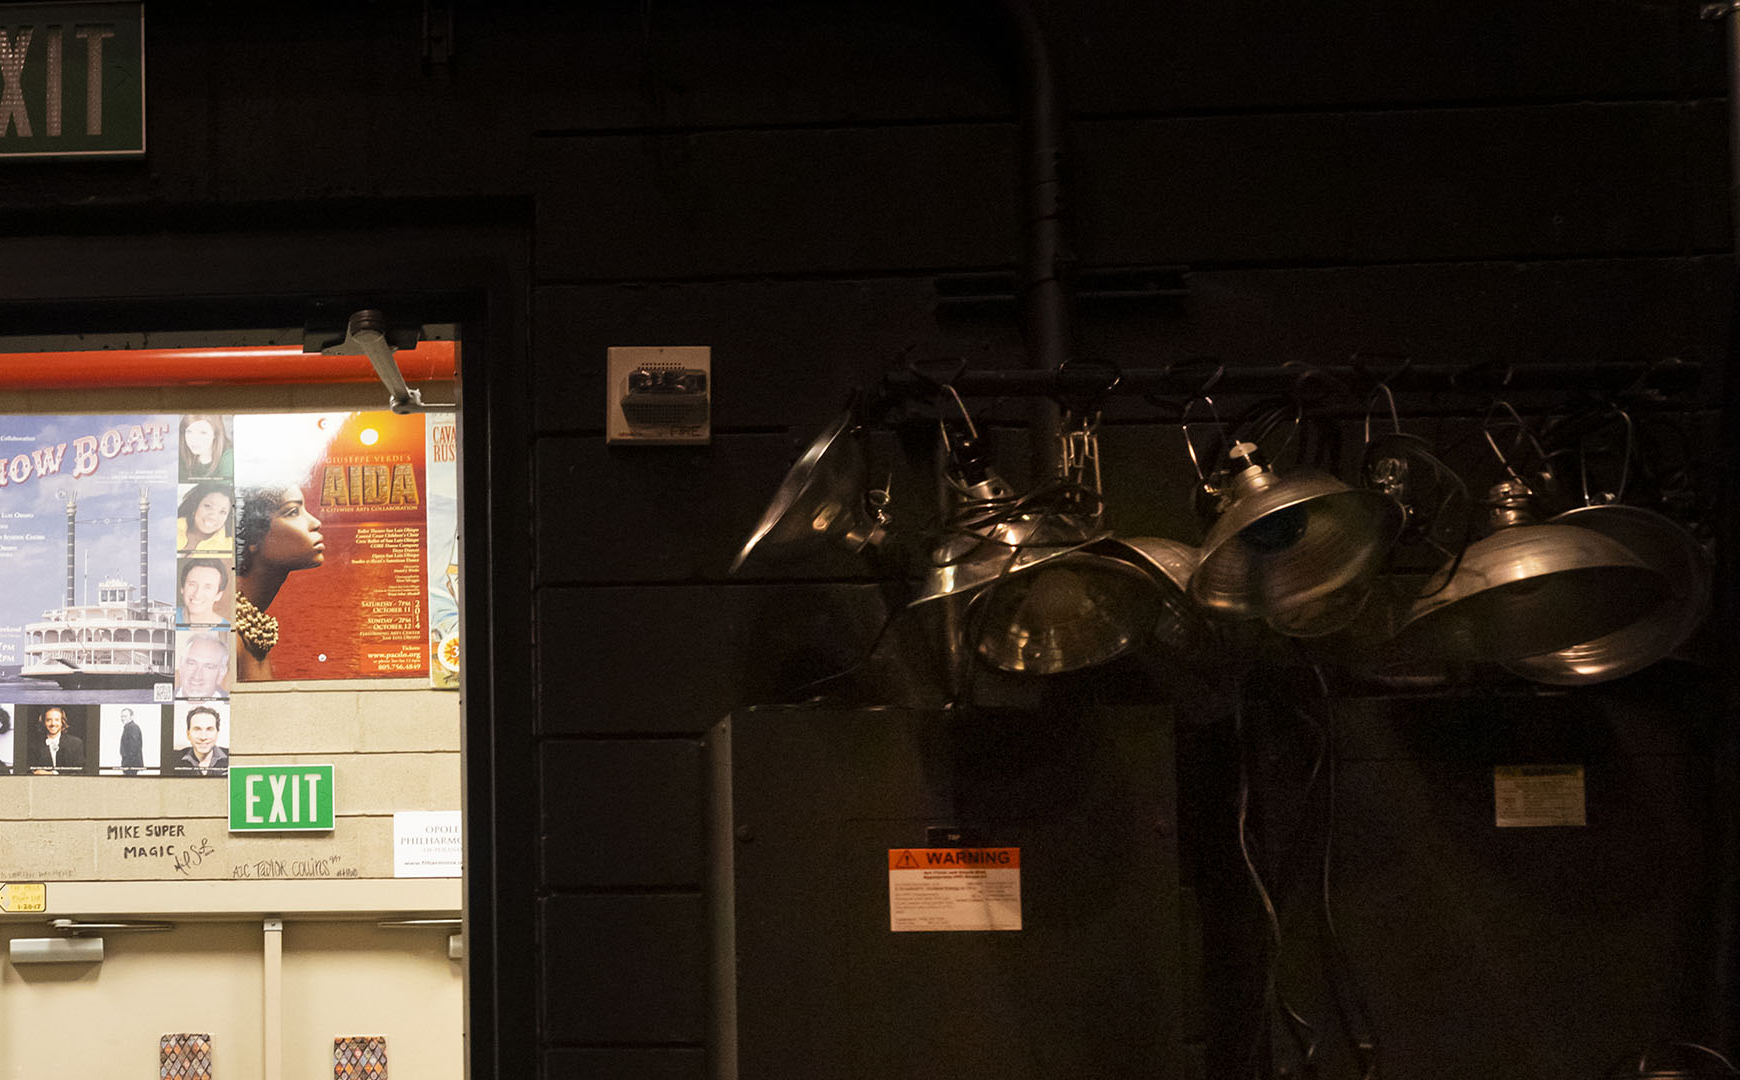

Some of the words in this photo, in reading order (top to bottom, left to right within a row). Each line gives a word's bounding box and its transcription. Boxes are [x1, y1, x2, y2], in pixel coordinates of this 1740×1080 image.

[72, 423, 169, 479] BOAT
[326, 455, 369, 465] GIUSEPPE
[373, 454, 412, 464] VERDI'S
[320, 463, 420, 507] AIDA
[246, 773, 322, 823] EXIT
[106, 825, 141, 841] MIKE
[145, 824, 185, 839] SUPER
[123, 844, 174, 860] MAGIC
[926, 851, 1011, 865] WARNING
